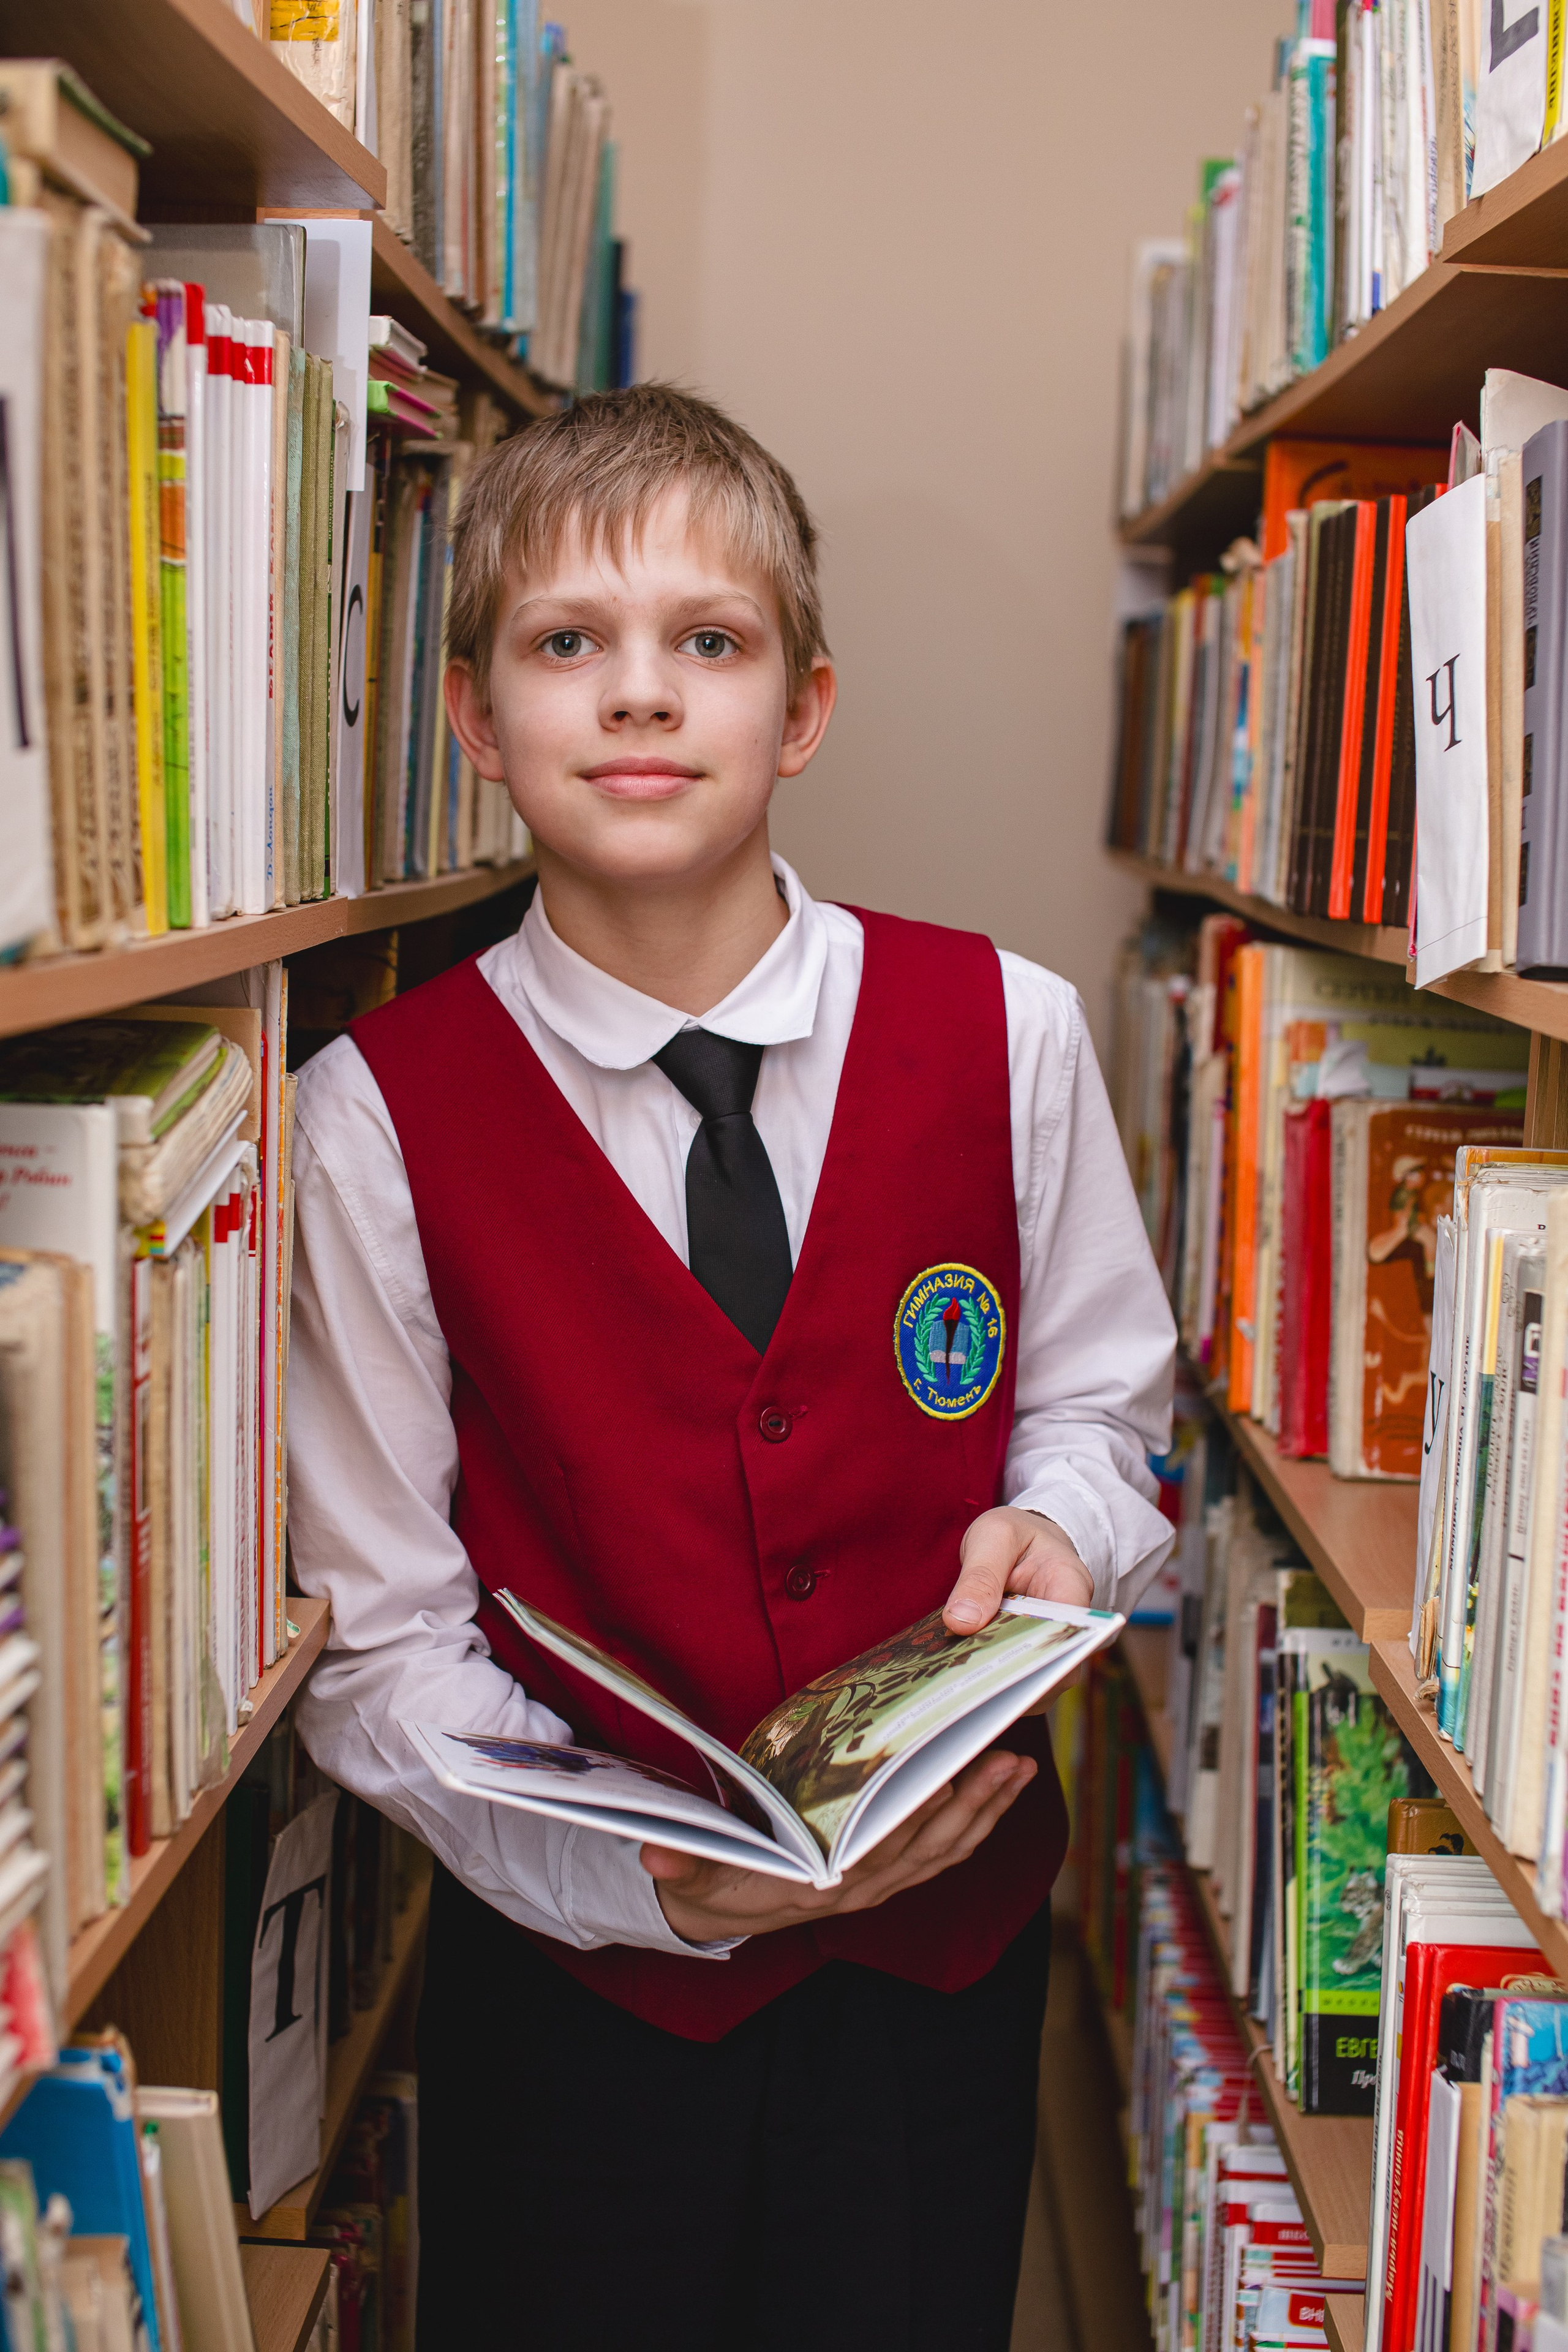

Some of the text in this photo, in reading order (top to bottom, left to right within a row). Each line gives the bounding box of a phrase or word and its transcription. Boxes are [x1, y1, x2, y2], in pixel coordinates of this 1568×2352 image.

[1425, 653, 1461, 753] Ч
[903, 1273, 975, 1328] ГИМНАЗИЯ
[987, 1317, 998, 1338] 16
[927, 1385, 981, 1408] Тюмень
[258, 1875, 326, 2043] Т
[1385, 2129, 1404, 2303] Марья-искусница
